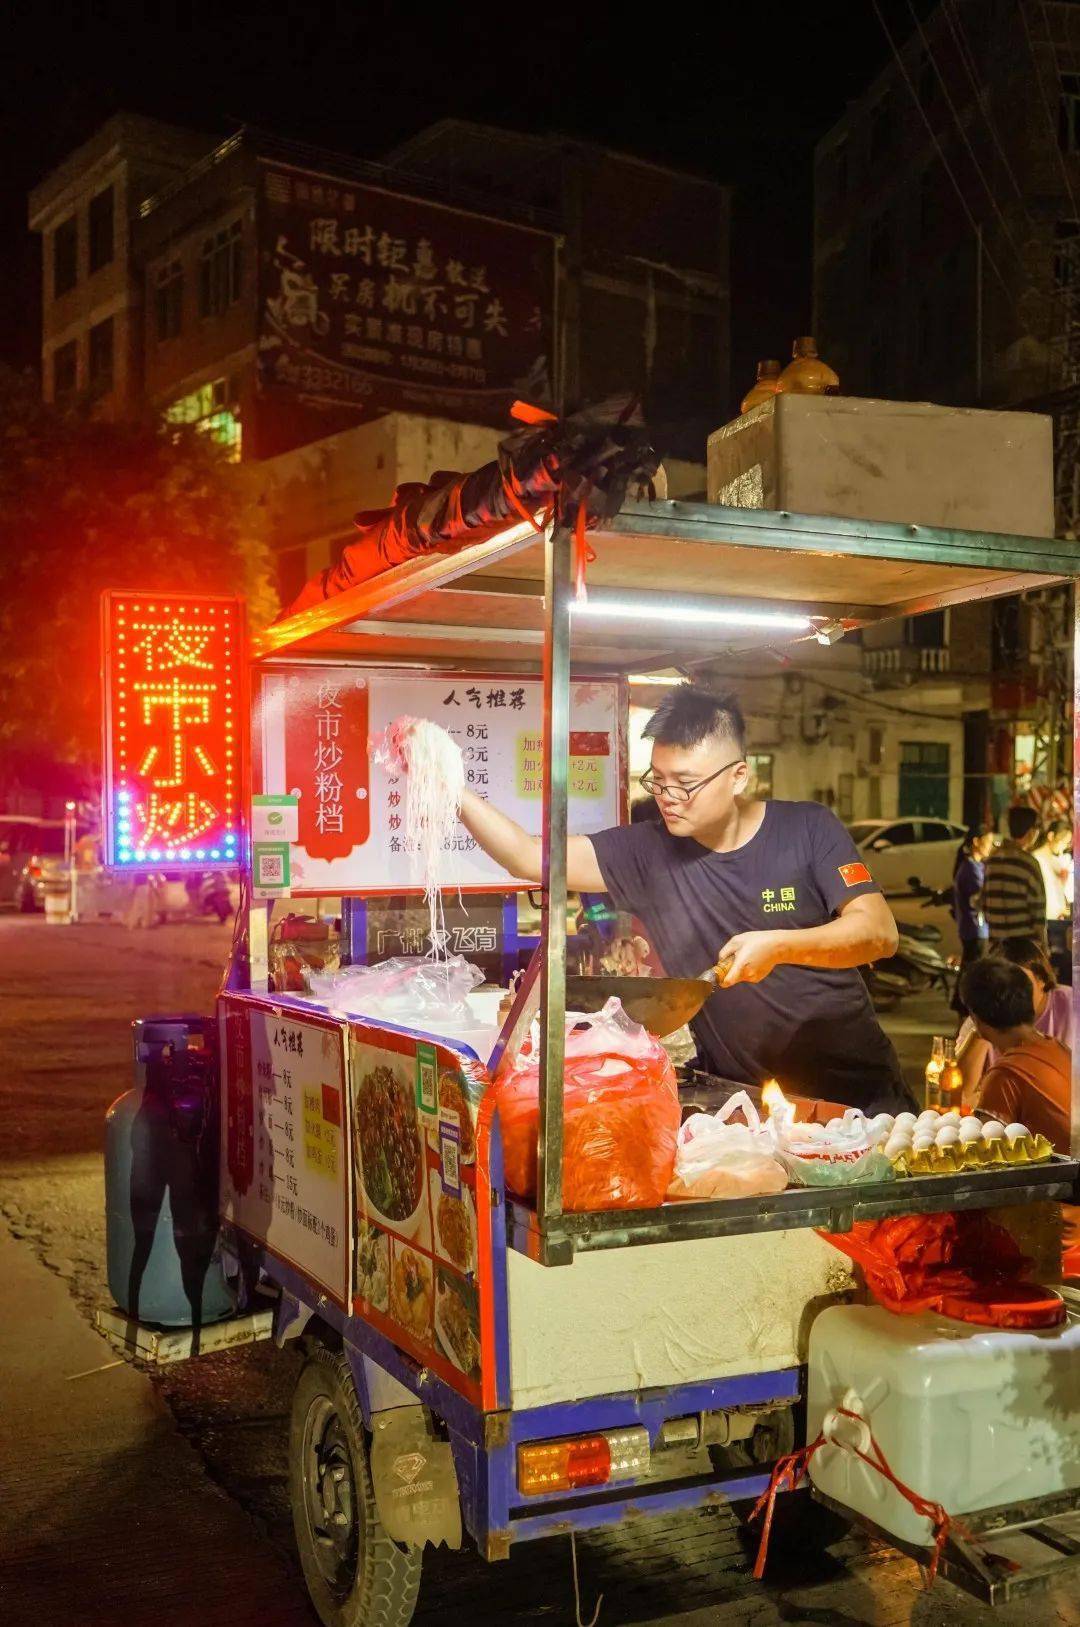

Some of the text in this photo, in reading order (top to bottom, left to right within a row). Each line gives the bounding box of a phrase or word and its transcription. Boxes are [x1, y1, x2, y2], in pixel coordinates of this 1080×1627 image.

[443, 687, 527, 711] 人气推荐
[133, 618, 217, 848] 夜市小炒
[314, 680, 344, 835] 夜市炒粉档
[761, 887, 795, 902] 中国
[763, 902, 795, 913] CHINA
[273, 1027, 304, 1059] 人气推荐
